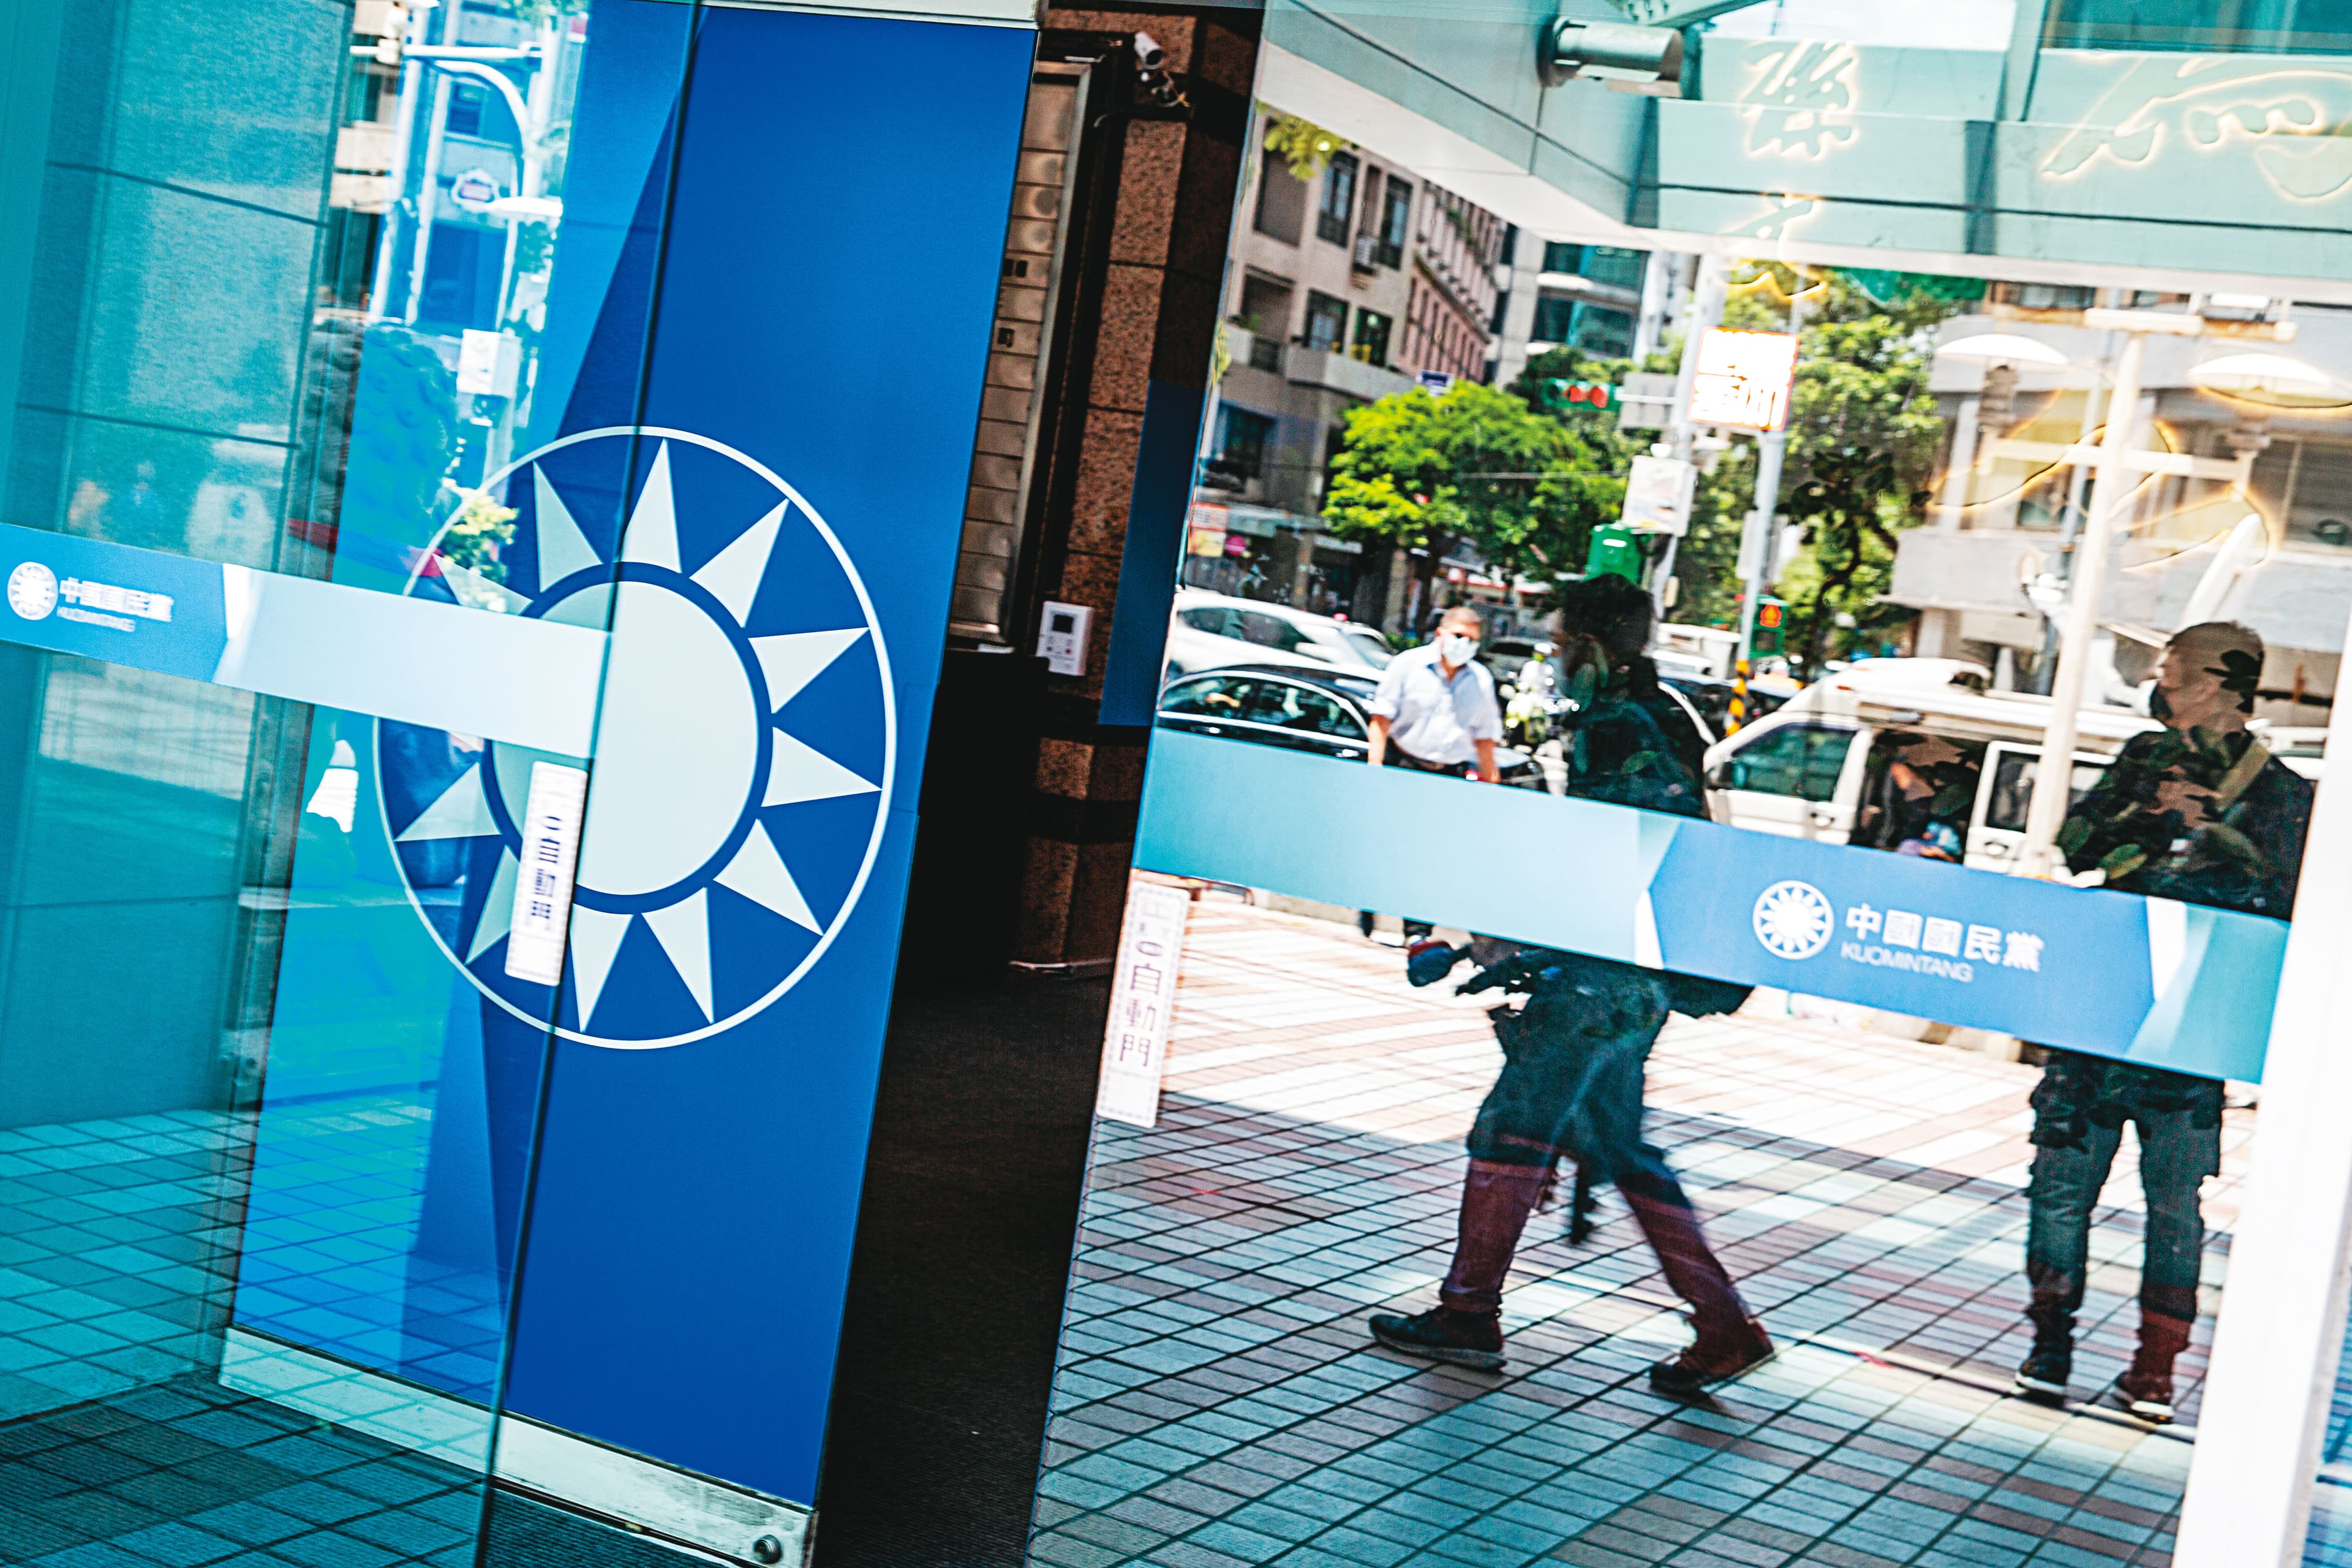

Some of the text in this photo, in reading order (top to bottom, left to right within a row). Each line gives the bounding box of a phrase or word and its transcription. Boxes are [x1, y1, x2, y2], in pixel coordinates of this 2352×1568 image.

[1840, 941, 1975, 984] KUOMINTANG
[1845, 902, 2045, 973] 中國國民黨
